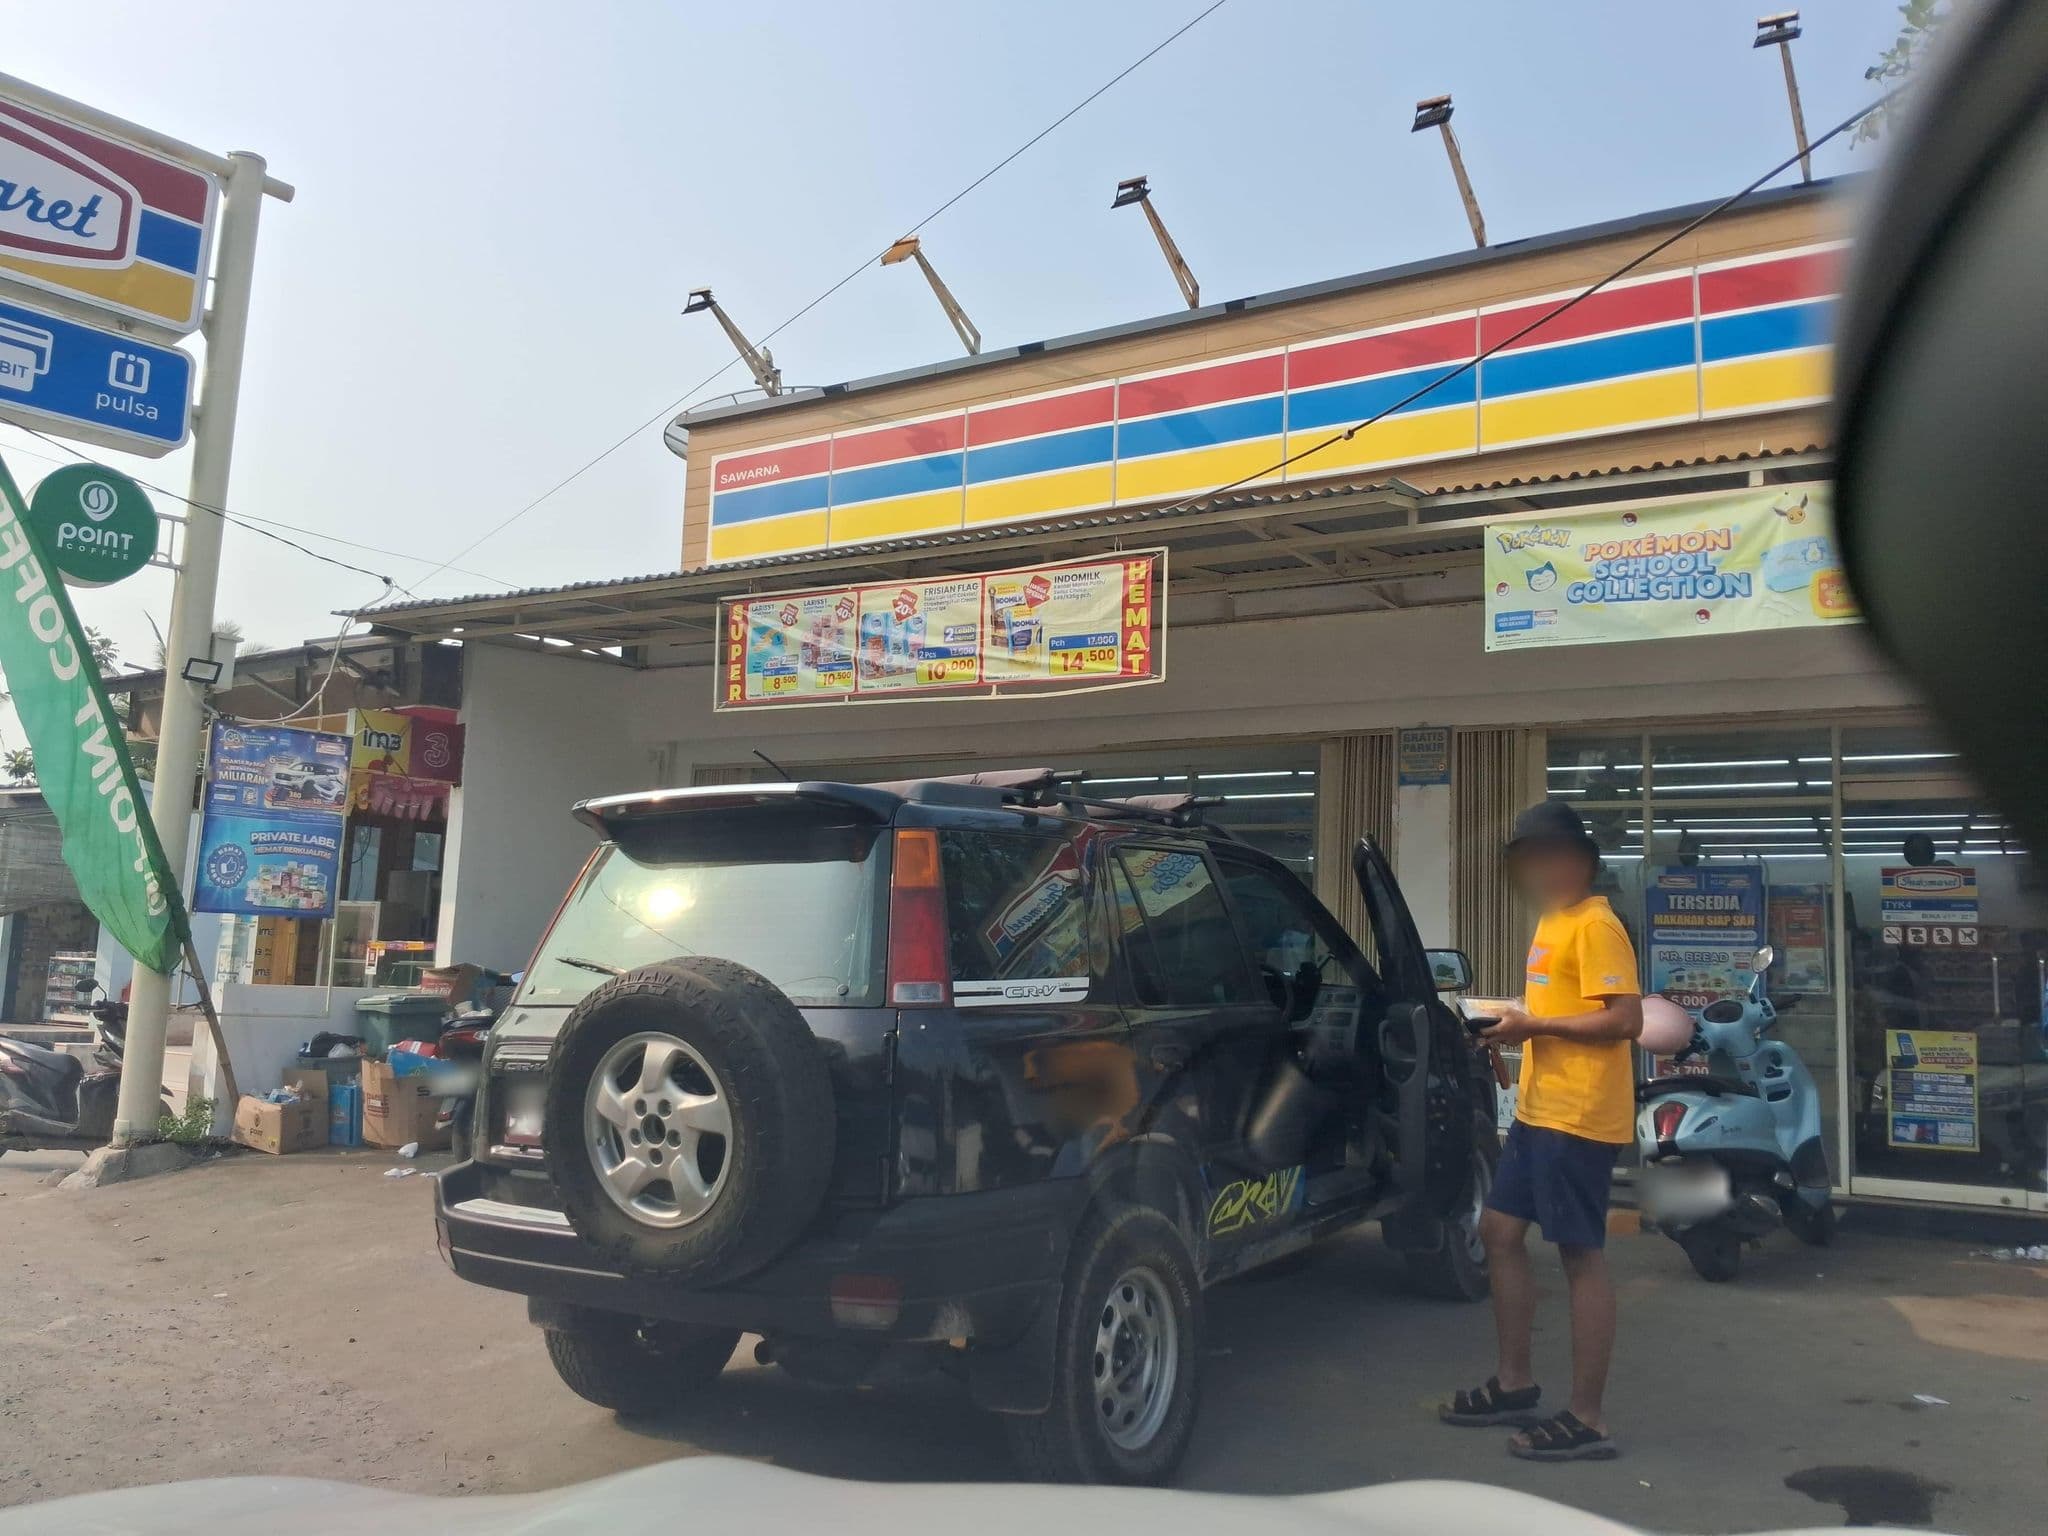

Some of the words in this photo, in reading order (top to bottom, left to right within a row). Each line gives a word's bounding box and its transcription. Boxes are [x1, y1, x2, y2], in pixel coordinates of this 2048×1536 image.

[95, 392, 158, 421] pulsa
[720, 464, 780, 484] SAWARNA
[66, 543, 129, 560] COFFEE
[1594, 551, 1717, 580] SCHOOL
[1054, 571, 1101, 583] INDOMILK
[1567, 571, 1753, 603] COLLECTION
[924, 585, 956, 596] FRISIAN
[957, 582, 979, 592] FLAG
[1126, 560, 1147, 674] HEMAT
[729, 604, 744, 701] SUPER
[1061, 648, 1115, 672] 14.500
[927, 658, 974, 680] 10.000
[424, 732, 450, 768] 3
[251, 832, 302, 843] PRIVATE
[303, 834, 337, 849] LABEL
[1668, 895, 1741, 910] TERSEDIA
[1659, 951, 1682, 962] MR.
[1685, 952, 1729, 962] BREAD
